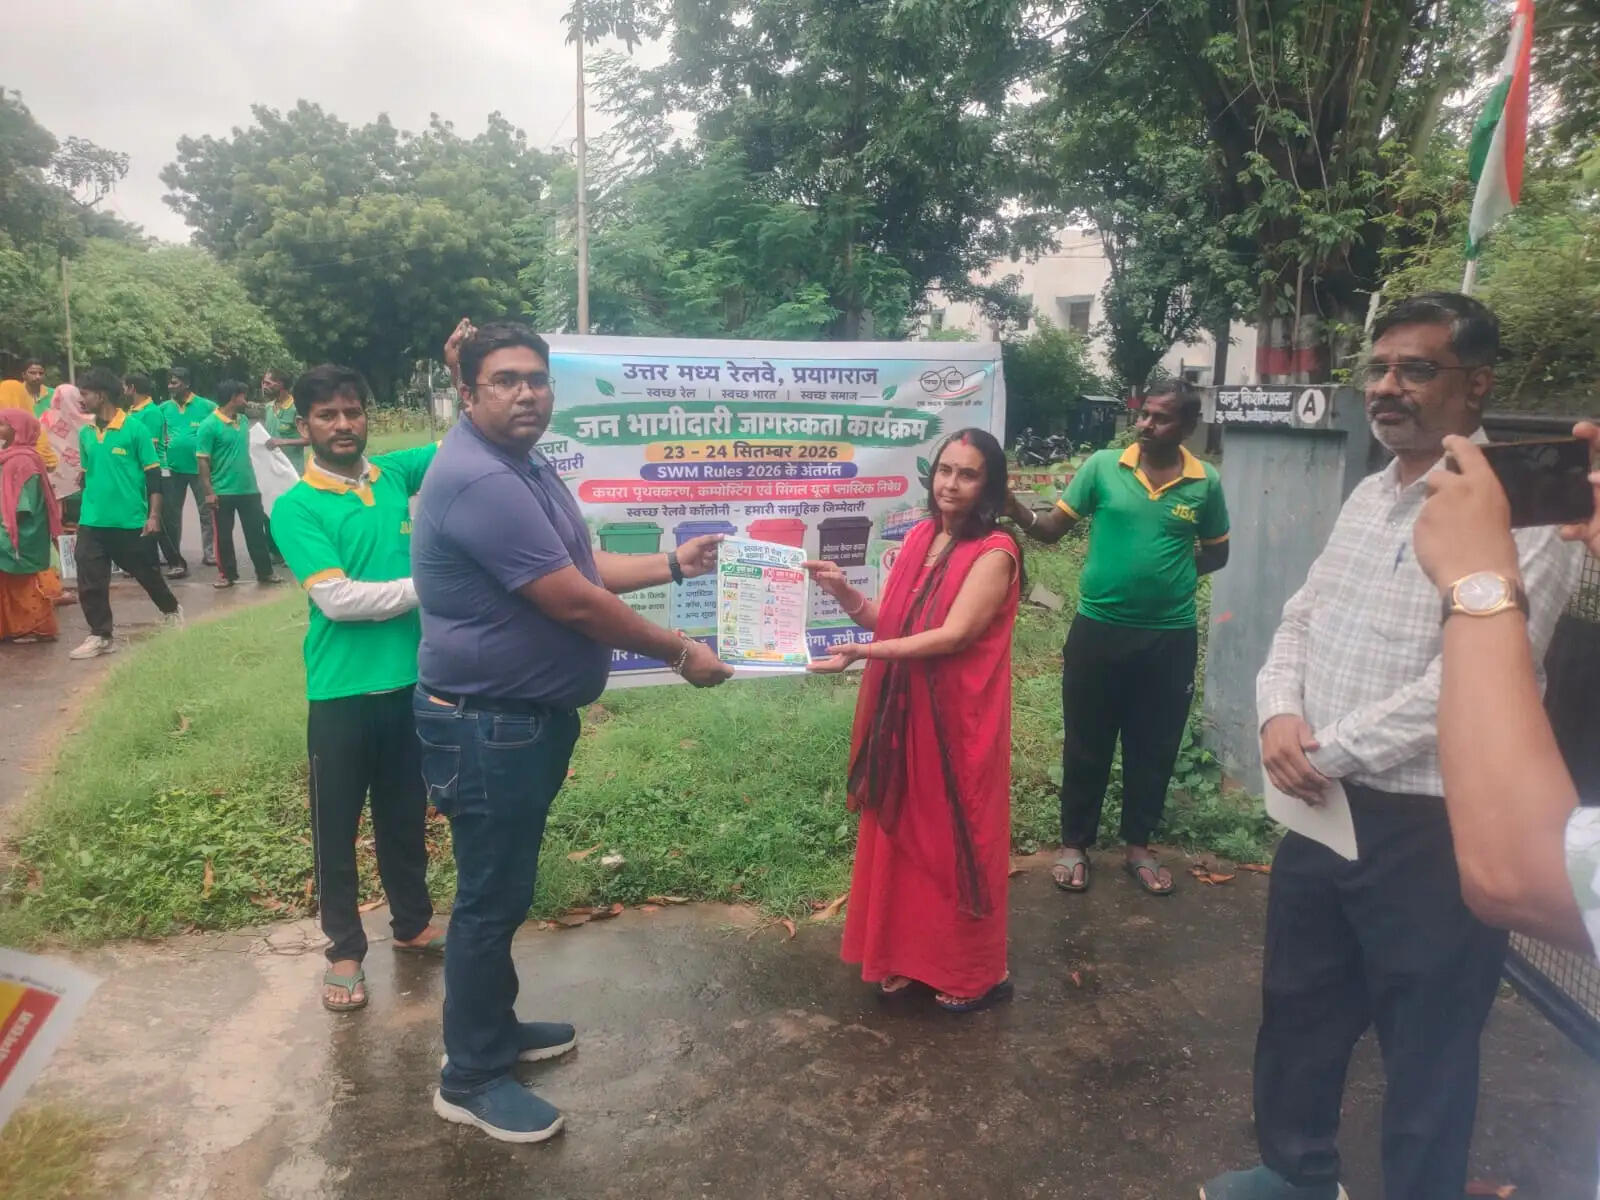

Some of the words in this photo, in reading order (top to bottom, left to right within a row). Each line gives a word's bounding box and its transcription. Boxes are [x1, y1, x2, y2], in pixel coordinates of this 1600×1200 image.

[622, 362, 669, 382] उत्तर
[676, 364, 721, 383] मध्य
[726, 361, 785, 386] रेलवे,
[792, 367, 879, 386] प्रयागराज
[646, 387, 677, 399] स्वच्छ
[679, 385, 697, 399] रेल
[721, 388, 749, 400] स्वच्छ
[752, 389, 777, 400] भारत
[800, 390, 827, 401] स्वच्छ
[830, 390, 858, 401] समाज
[1302, 392, 1317, 417] A
[573, 414, 621, 439] जन
[626, 404, 734, 437] भागीदारी
[847, 408, 929, 441] कार्यक्रम
[536, 440, 569, 454] चरा
[663, 446, 686, 460] 23
[705, 445, 728, 459] 24
[733, 440, 793, 459] सितम्बर
[799, 446, 838, 459] 2026
[657, 465, 699, 479] SWM
[703, 463, 743, 478] Rules
[747, 464, 782, 478] 2026
[784, 463, 798, 477] के
[800, 462, 842, 477] अंतर्गत
[591, 485, 628, 499] कचरा
[756, 481, 773, 497] एवं
[775, 480, 808, 496] सिंगल
[810, 483, 830, 498] यूज
[832, 480, 875, 496] प्लास्टिक
[626, 506, 660, 518] स्वच्छ
[662, 504, 687, 517] रेलवे
[689, 503, 730, 517] कॉलोनी
[744, 503, 776, 517] हमारी
[823, 500, 867, 514] जिम्मेदारी
[805, 631, 831, 648] ोगा,
